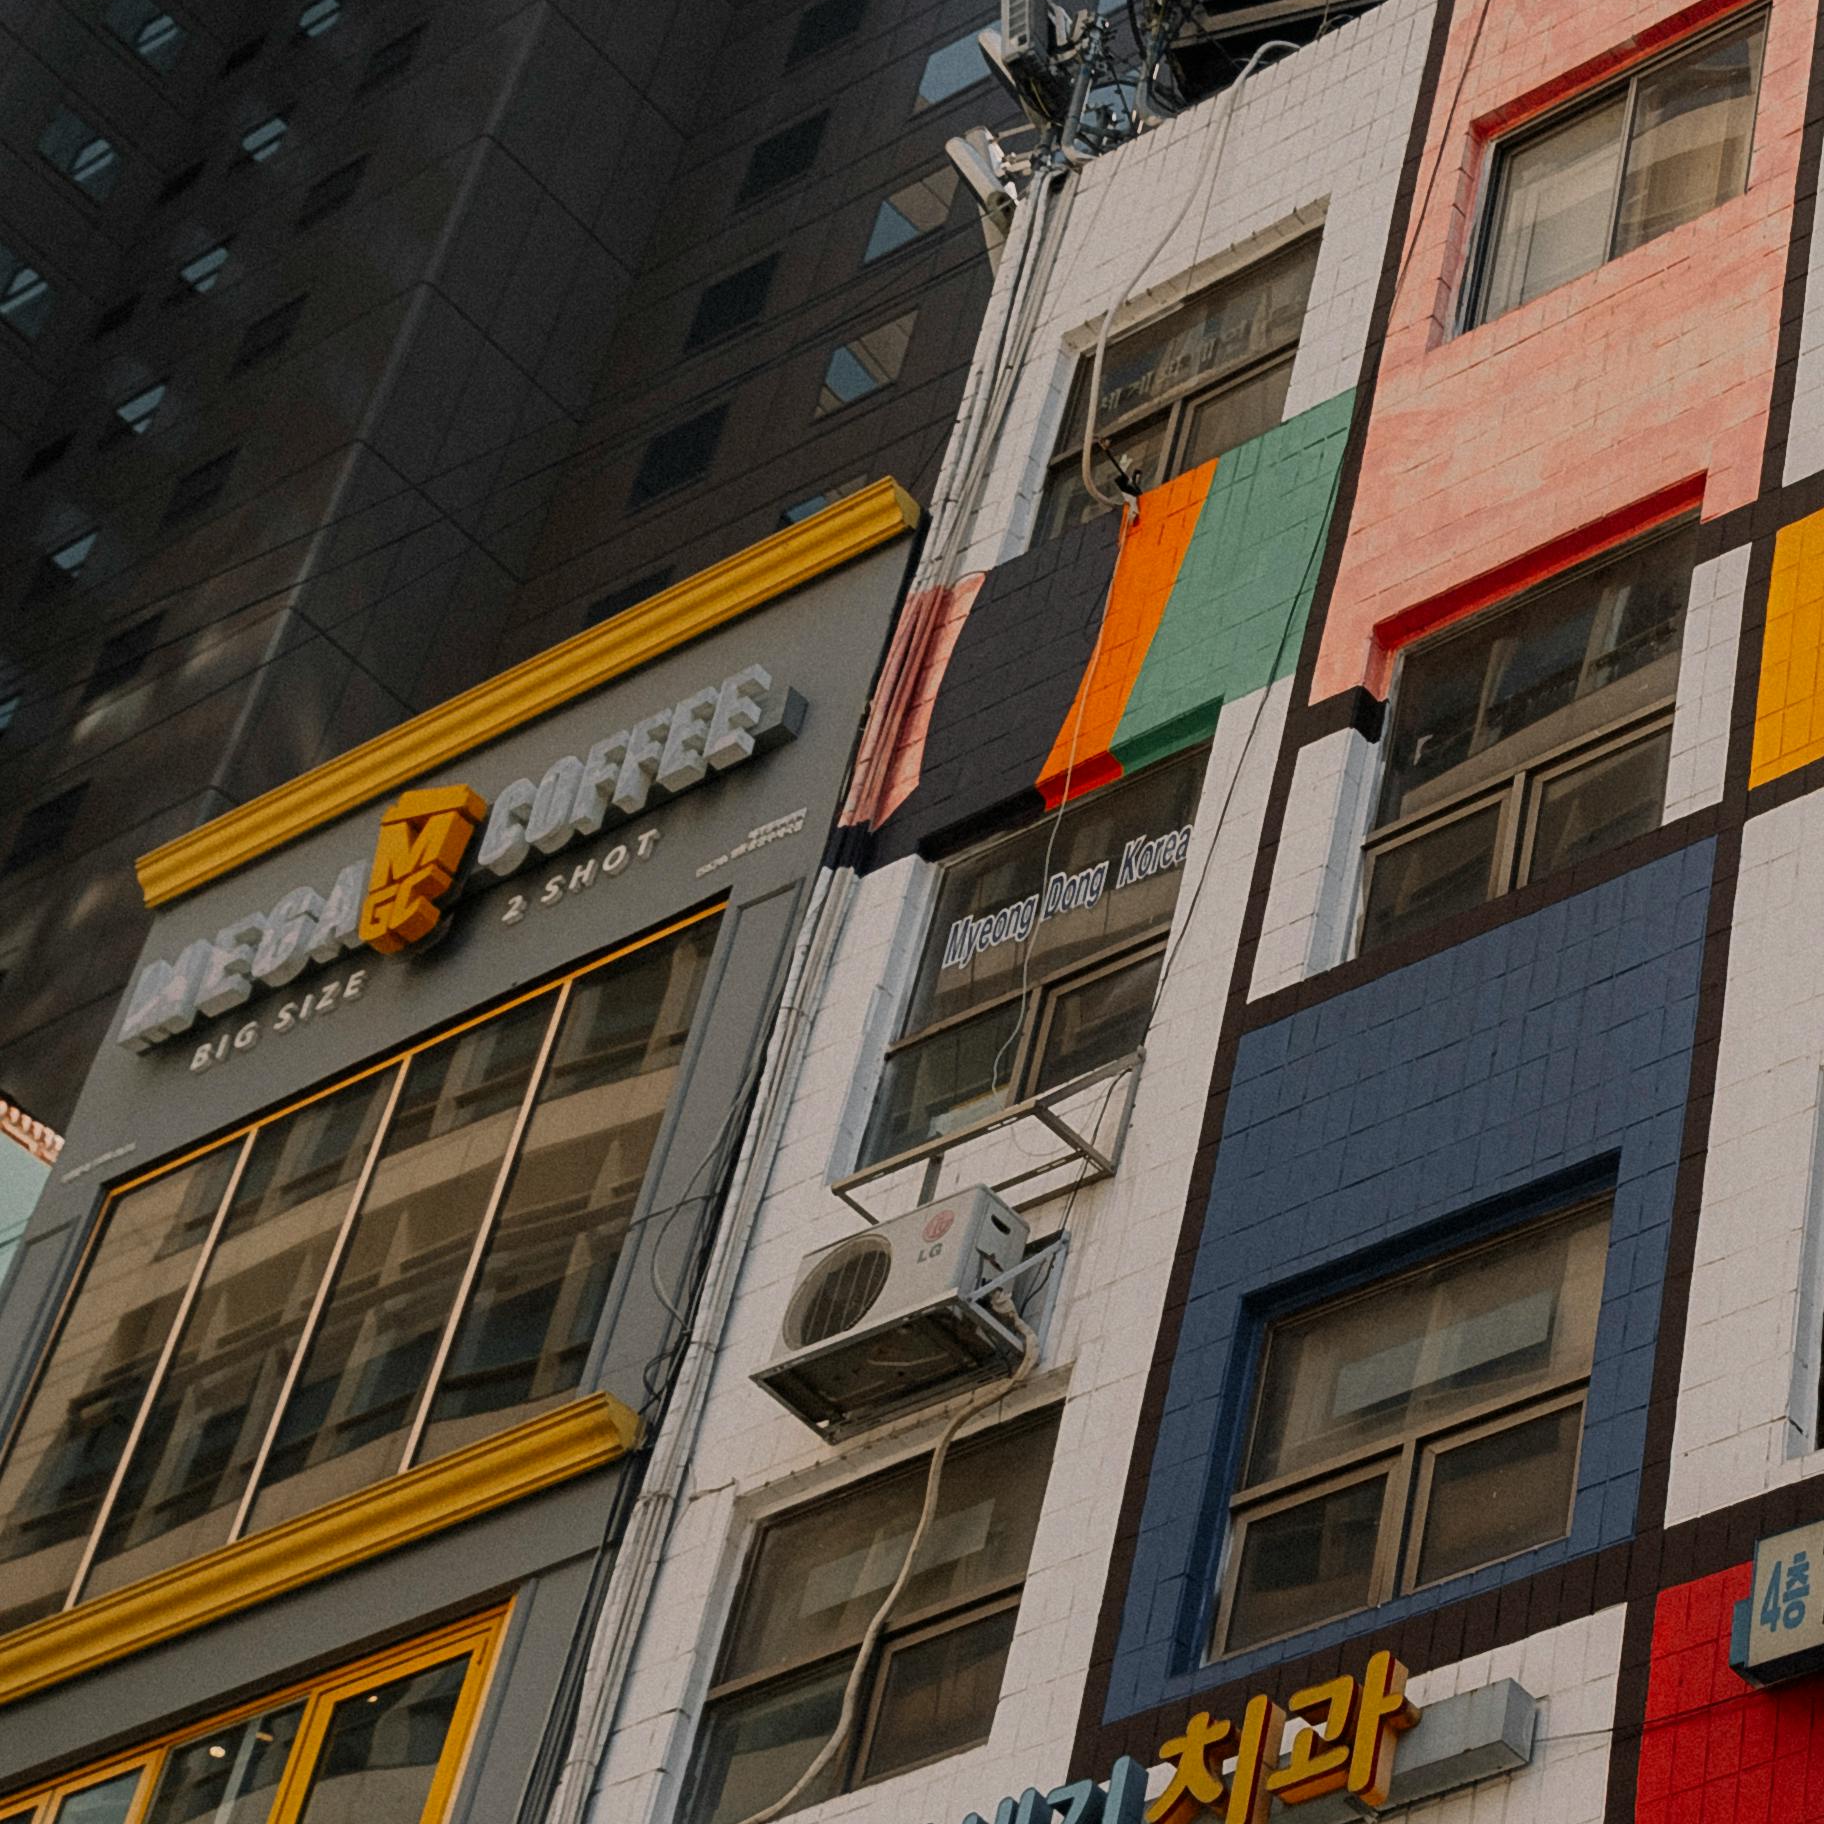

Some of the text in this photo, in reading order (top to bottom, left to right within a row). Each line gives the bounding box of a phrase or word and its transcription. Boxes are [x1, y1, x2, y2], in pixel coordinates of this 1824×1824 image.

[477, 662, 774, 877] COFFEE
[188, 1020, 258, 1074] BIG
[272, 969, 368, 1034] SIZE
[540, 828, 660, 909] SHOT
[941, 824, 1193, 970] Myeong Dong Korea
[916, 1242, 943, 1264] LG
[1759, 1550, 1811, 1633] 4층
